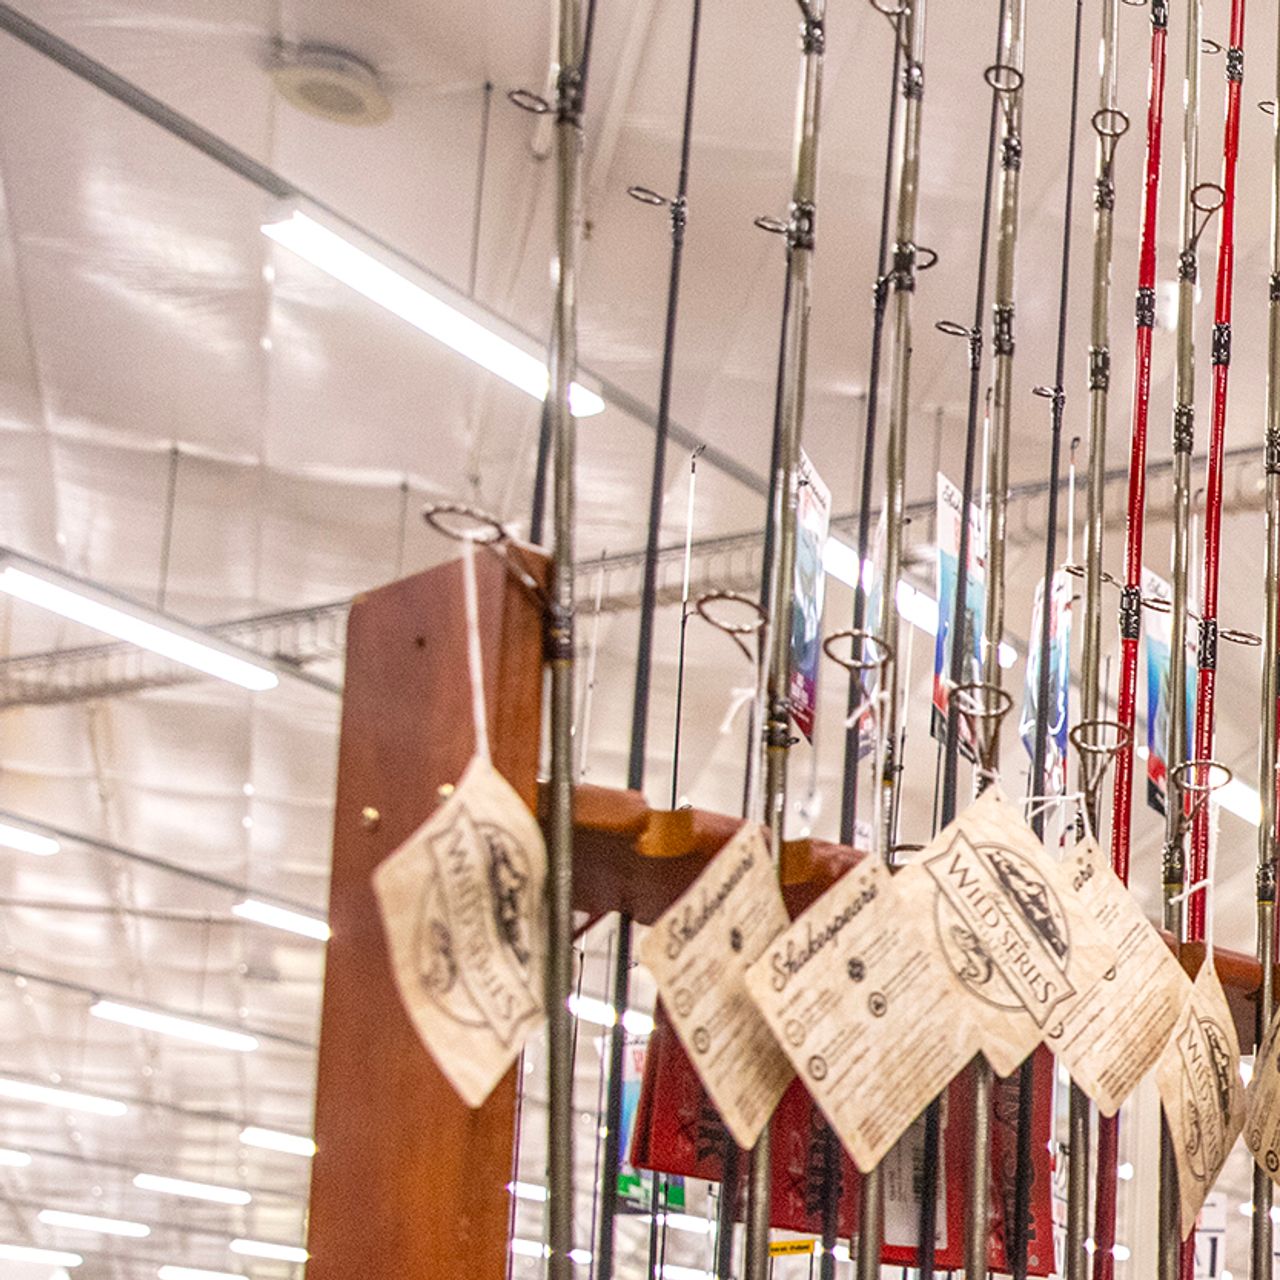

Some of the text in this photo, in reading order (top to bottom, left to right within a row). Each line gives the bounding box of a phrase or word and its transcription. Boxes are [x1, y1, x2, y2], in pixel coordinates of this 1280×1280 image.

[770, 884, 879, 993] Shakespeare
[946, 853, 1001, 930] WILD
[998, 925, 1057, 1006] SERIES
